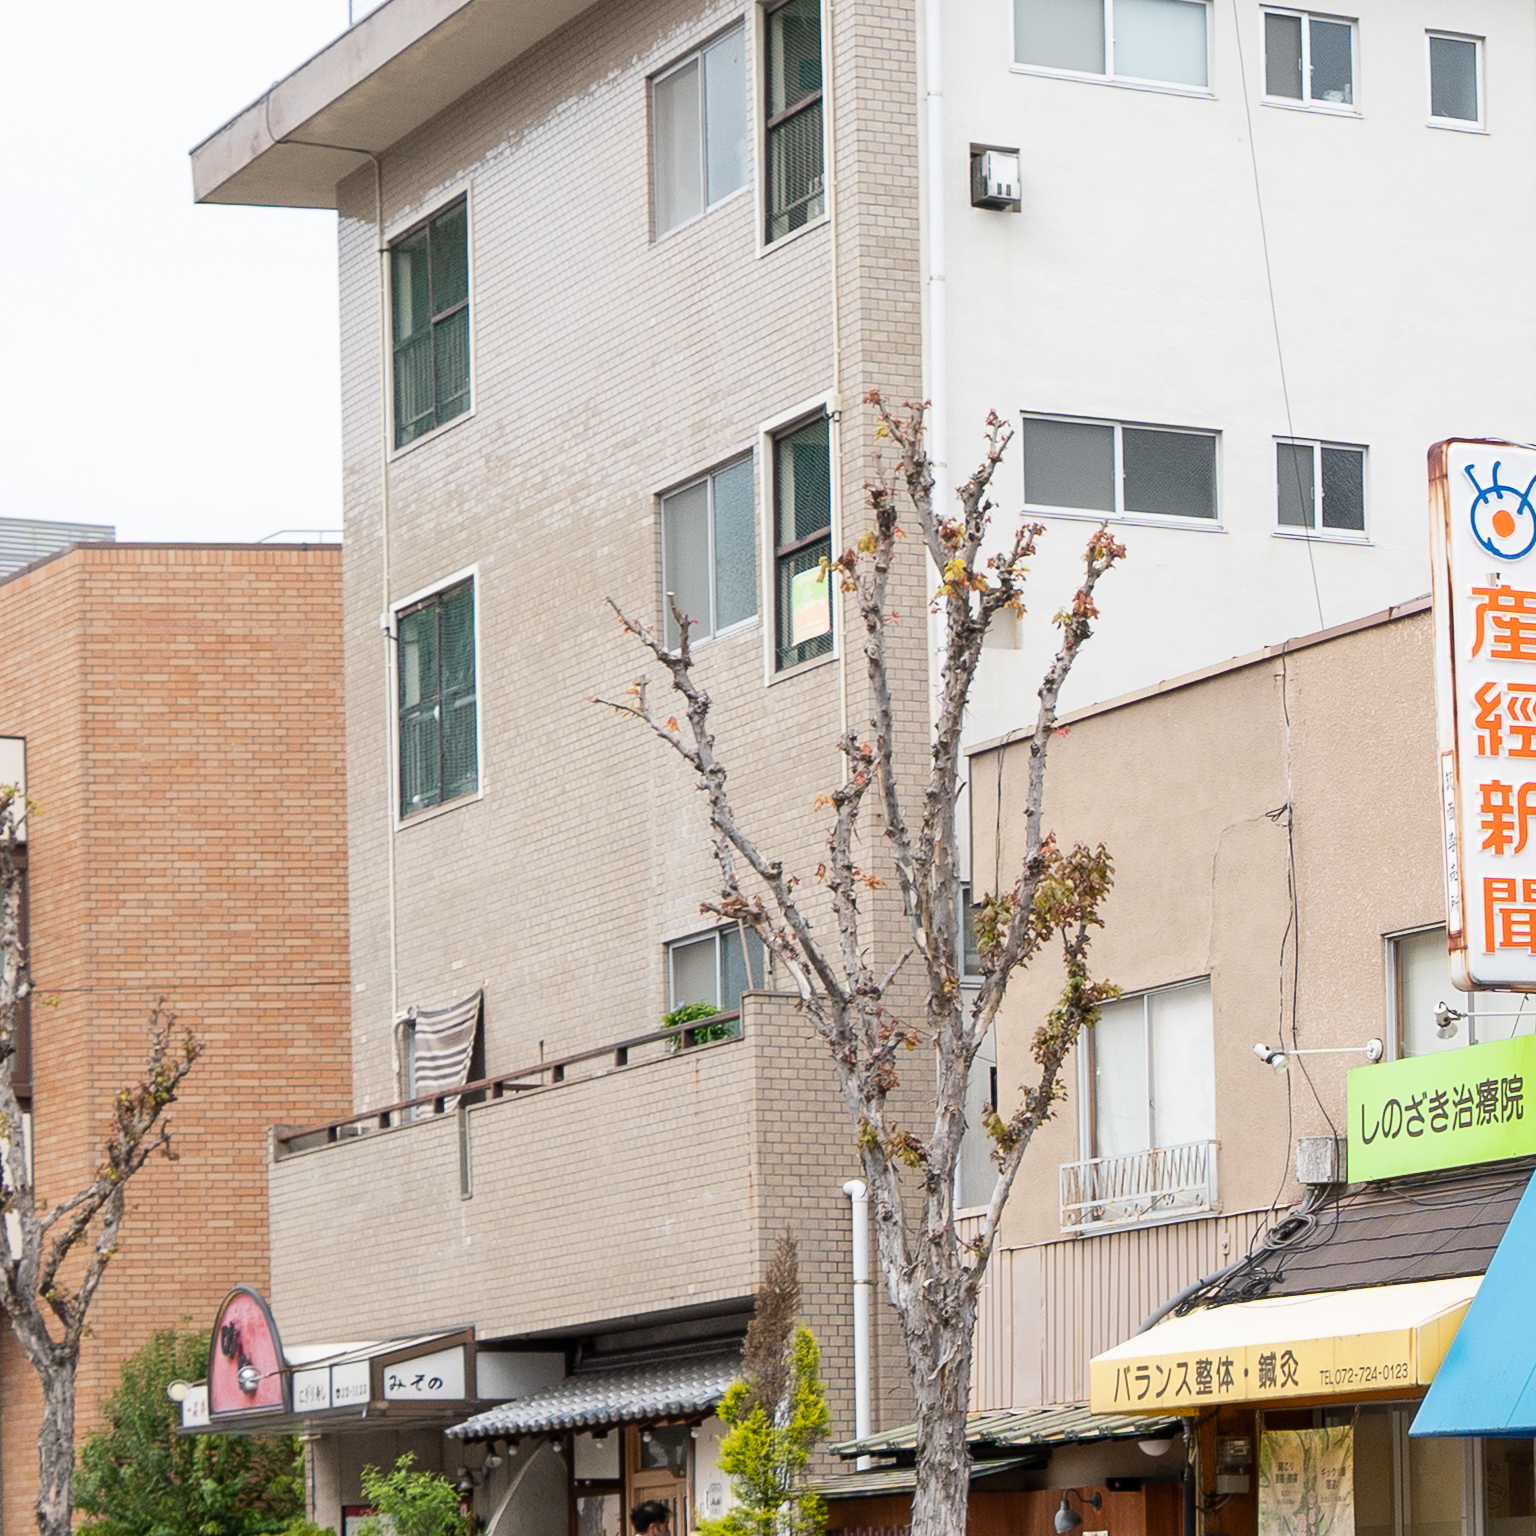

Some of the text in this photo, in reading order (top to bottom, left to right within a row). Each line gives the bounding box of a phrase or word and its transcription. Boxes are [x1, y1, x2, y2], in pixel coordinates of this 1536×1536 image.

[1361, 1073, 1524, 1146] しのざき治療院
[1113, 1350, 1300, 1402] バランス整体・鍼灸
